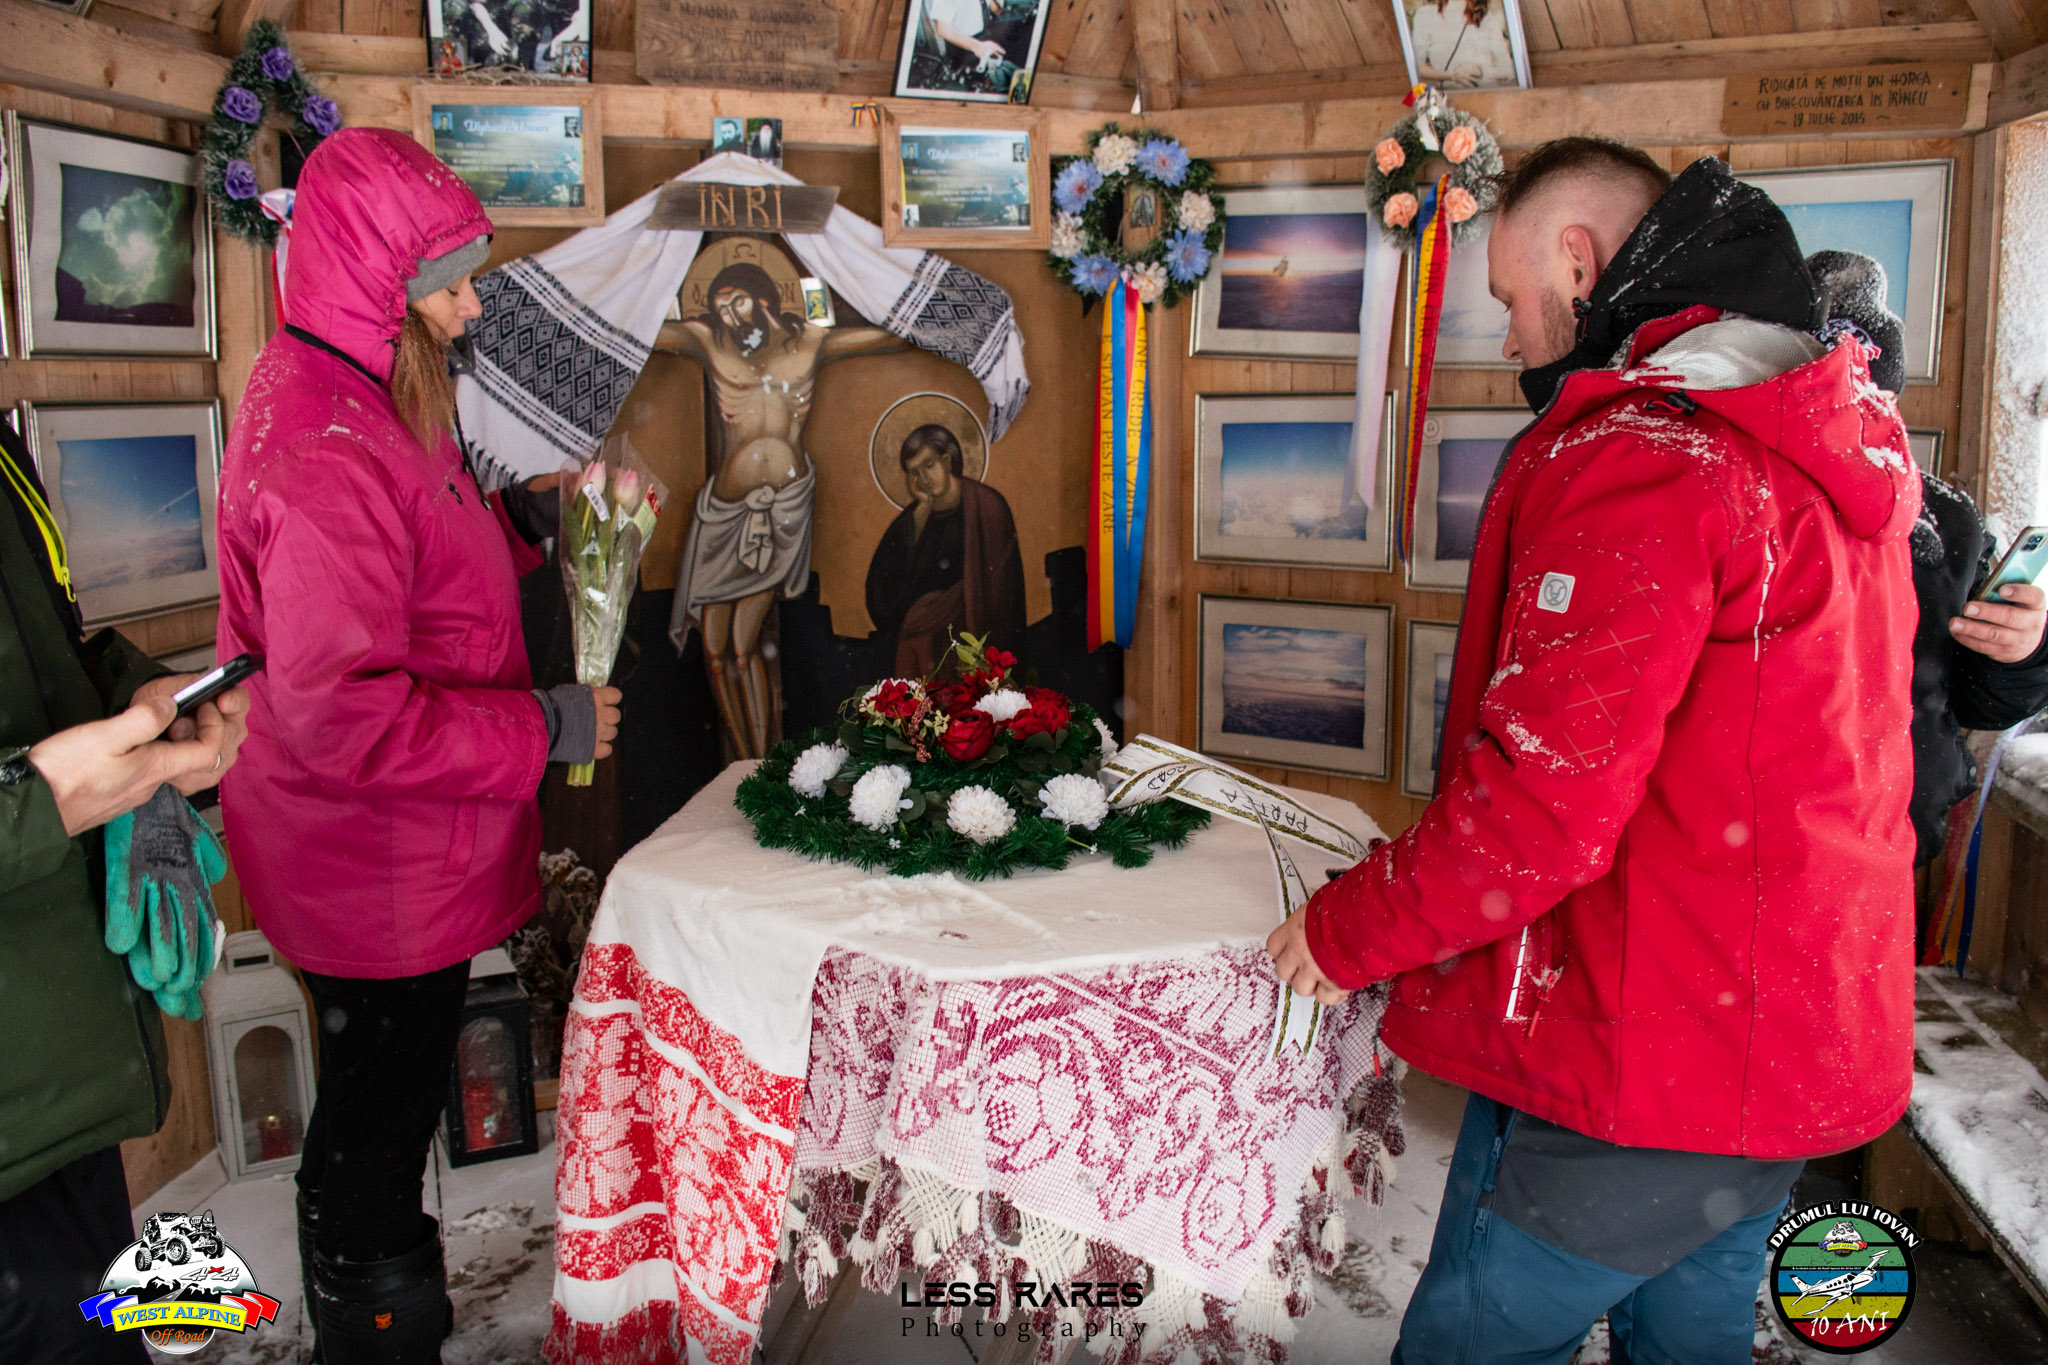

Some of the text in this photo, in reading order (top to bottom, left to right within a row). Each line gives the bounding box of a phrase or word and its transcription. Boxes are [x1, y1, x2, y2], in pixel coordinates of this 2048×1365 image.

[1815, 74, 1827, 90] DE
[1867, 73, 1884, 88] DIN
[1888, 71, 1931, 86] HOREA
[1793, 112, 1805, 128] 19
[1808, 111, 1836, 126] IULIE
[698, 183, 783, 230] INRI
[1424, 262, 1442, 294] DIN
[1127, 379, 1145, 438] CREDE
[1102, 430, 1114, 482] PESTE
[1102, 491, 1116, 535] ZARE
